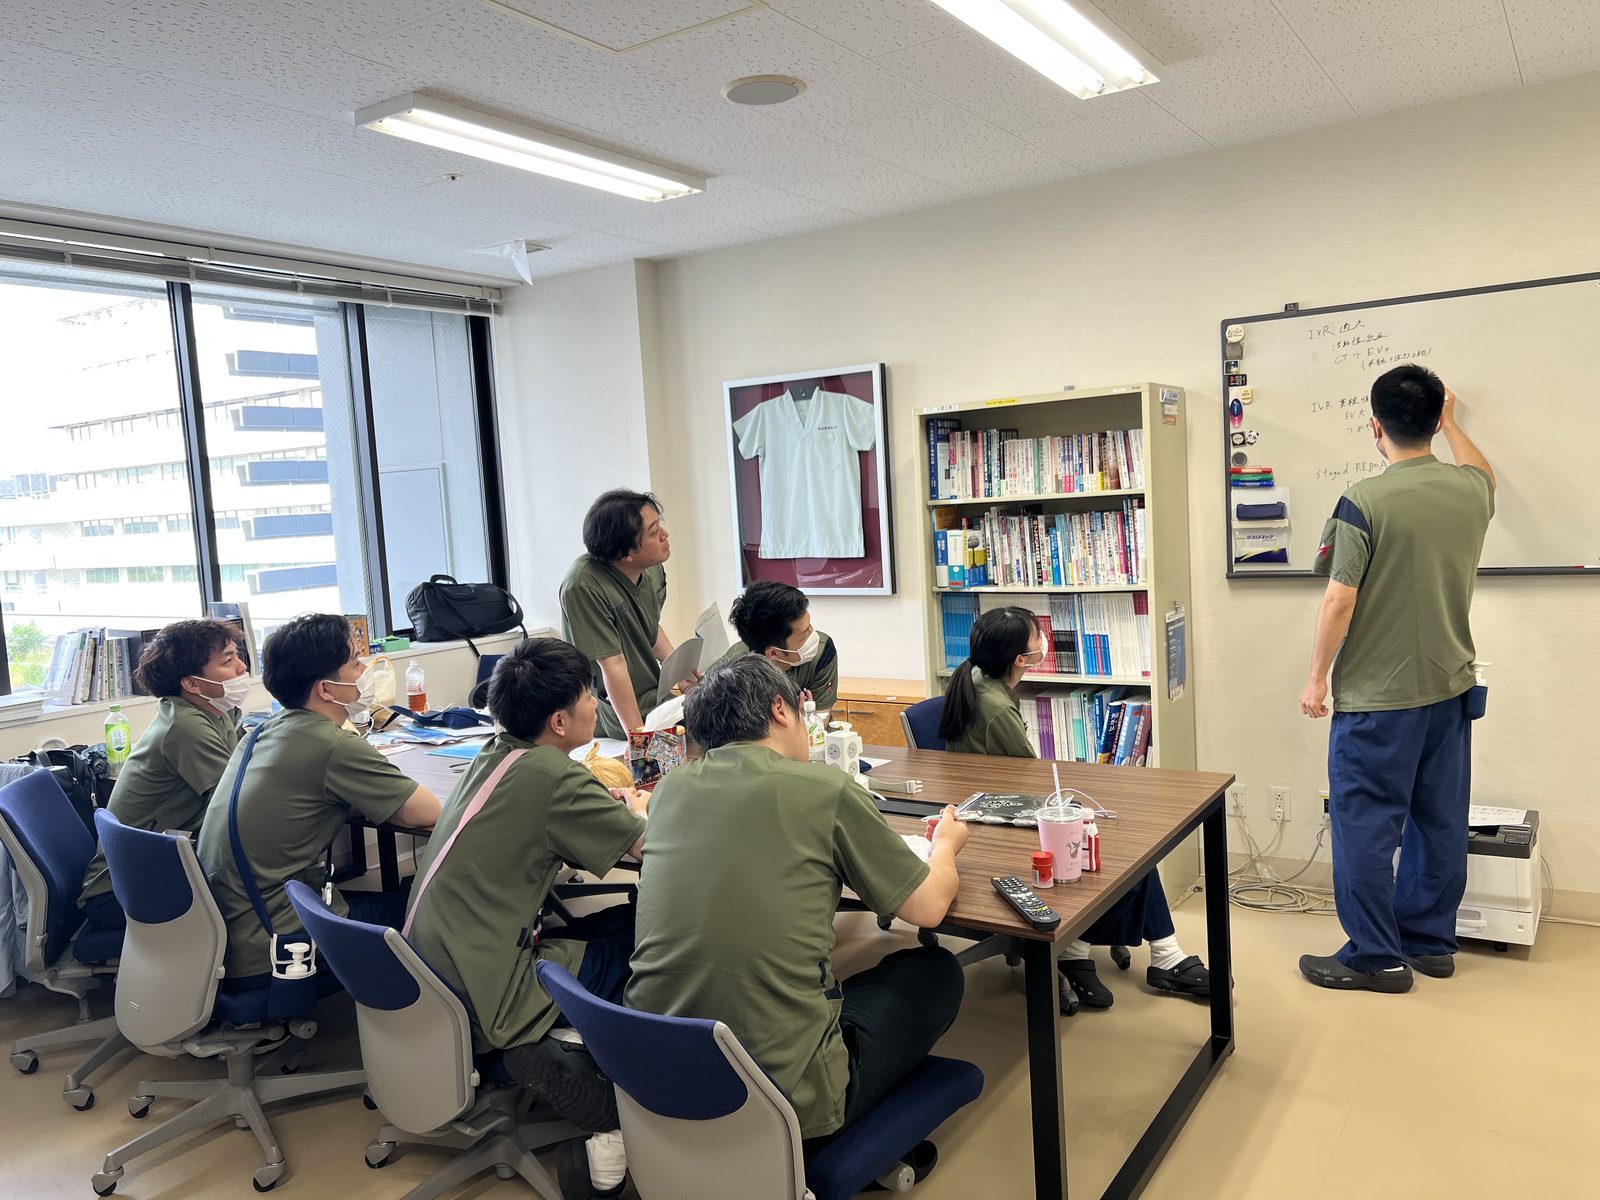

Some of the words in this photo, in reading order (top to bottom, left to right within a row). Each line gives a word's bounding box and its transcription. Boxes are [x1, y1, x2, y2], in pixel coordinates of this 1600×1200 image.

[1307, 325, 1336, 340] IVR
[1312, 401, 1333, 413] IVR
[1315, 462, 1350, 480] staged
[1355, 460, 1387, 472] REBOA
